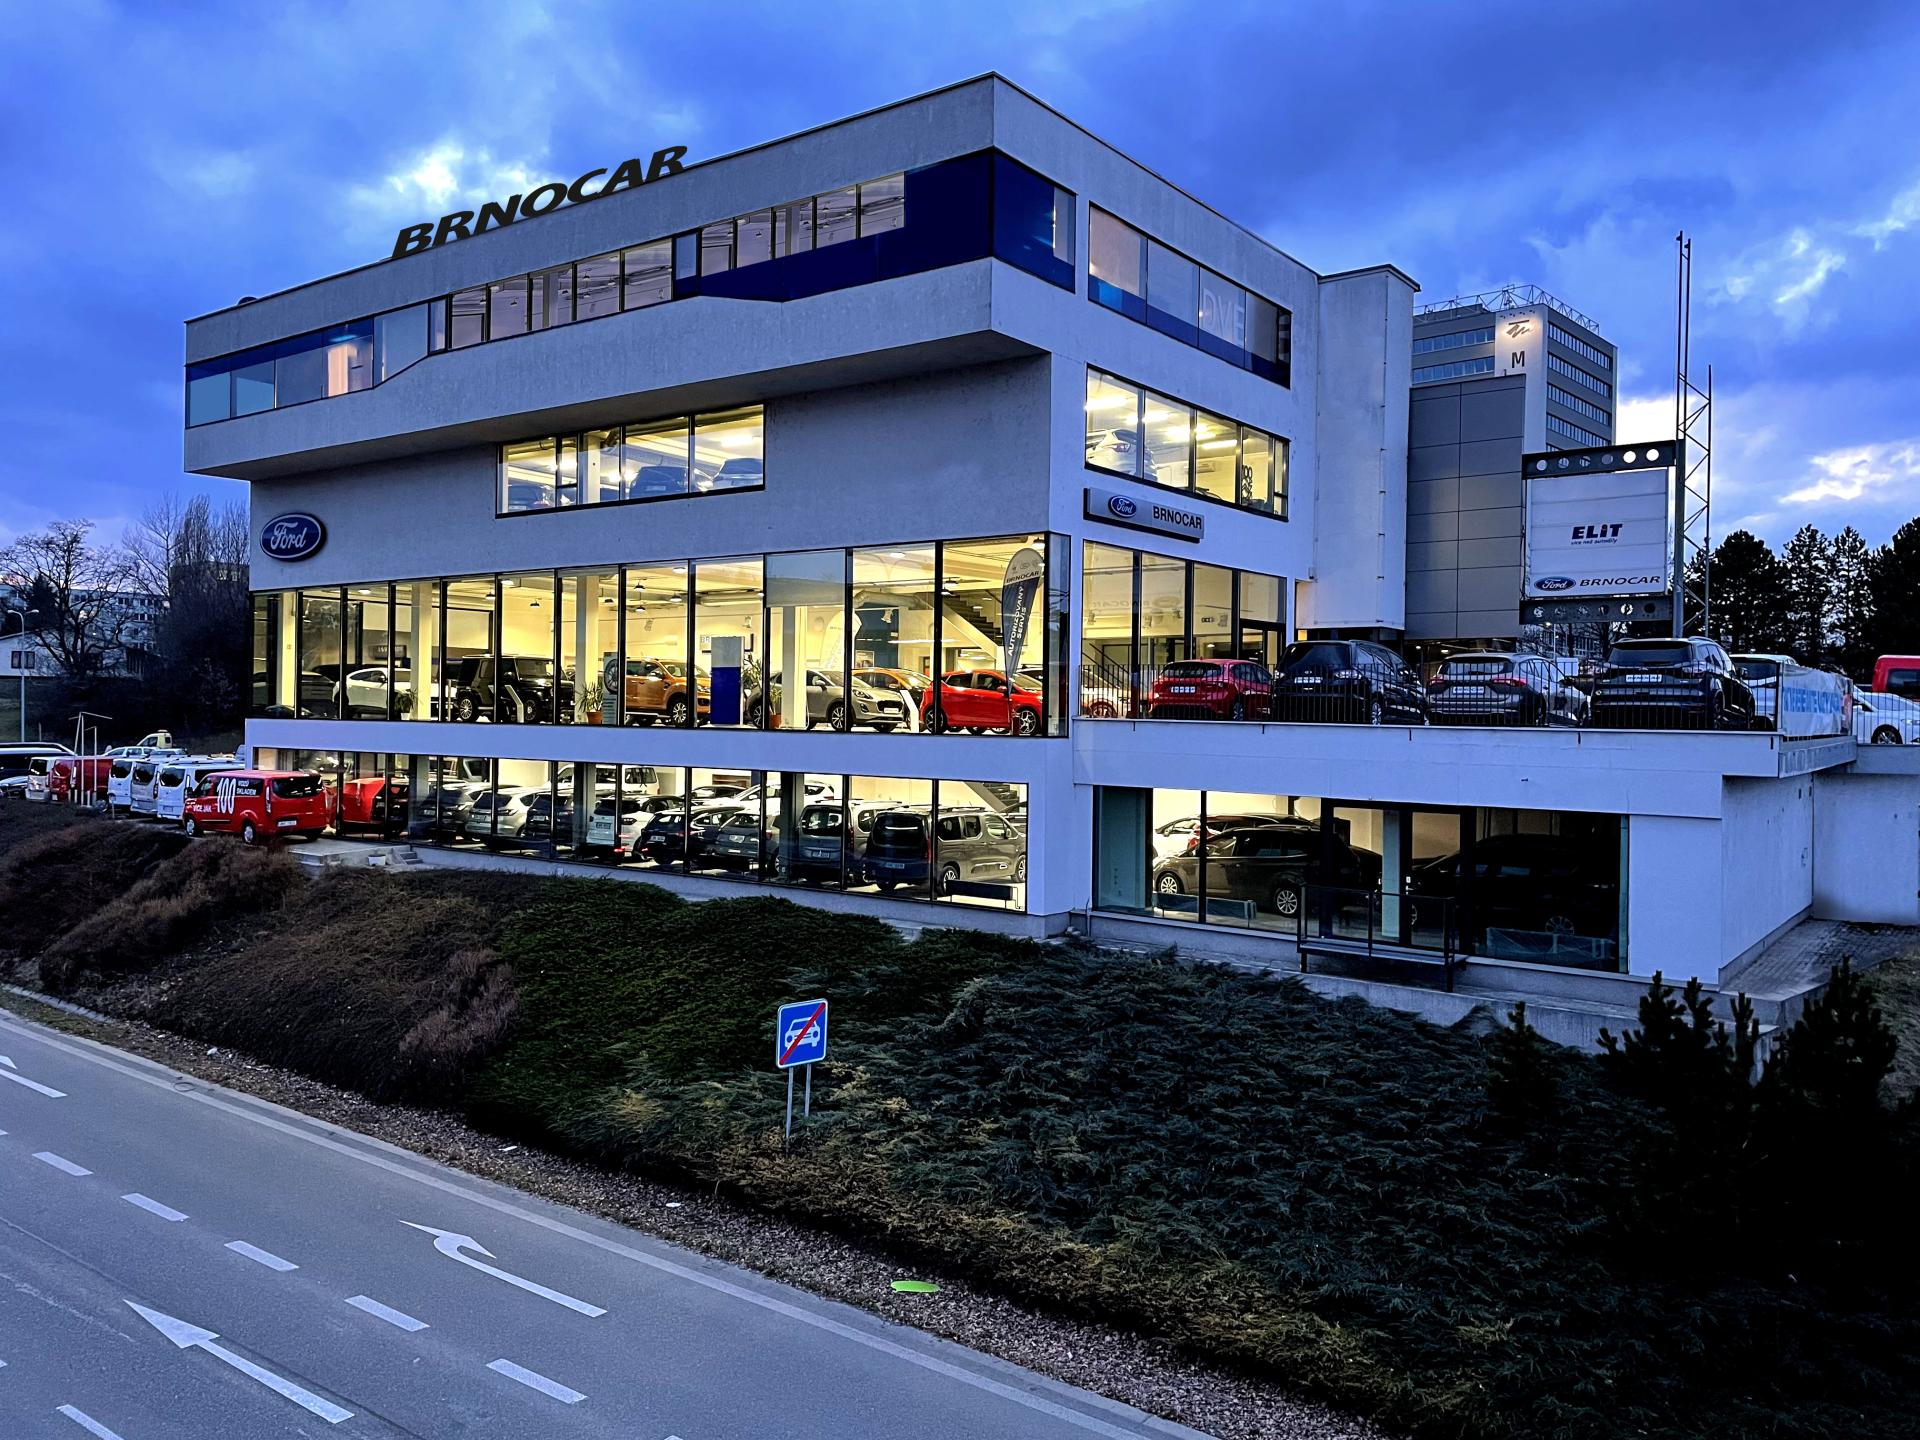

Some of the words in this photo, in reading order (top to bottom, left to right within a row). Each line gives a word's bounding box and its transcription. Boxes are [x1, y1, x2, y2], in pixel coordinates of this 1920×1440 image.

[392, 145, 688, 258] BRNOCAR
[1153, 505, 1202, 529] BRNOCAR
[270, 522, 307, 550] Ford
[1580, 575, 1661, 587] BRNOCAR
[217, 777, 237, 815] 100
